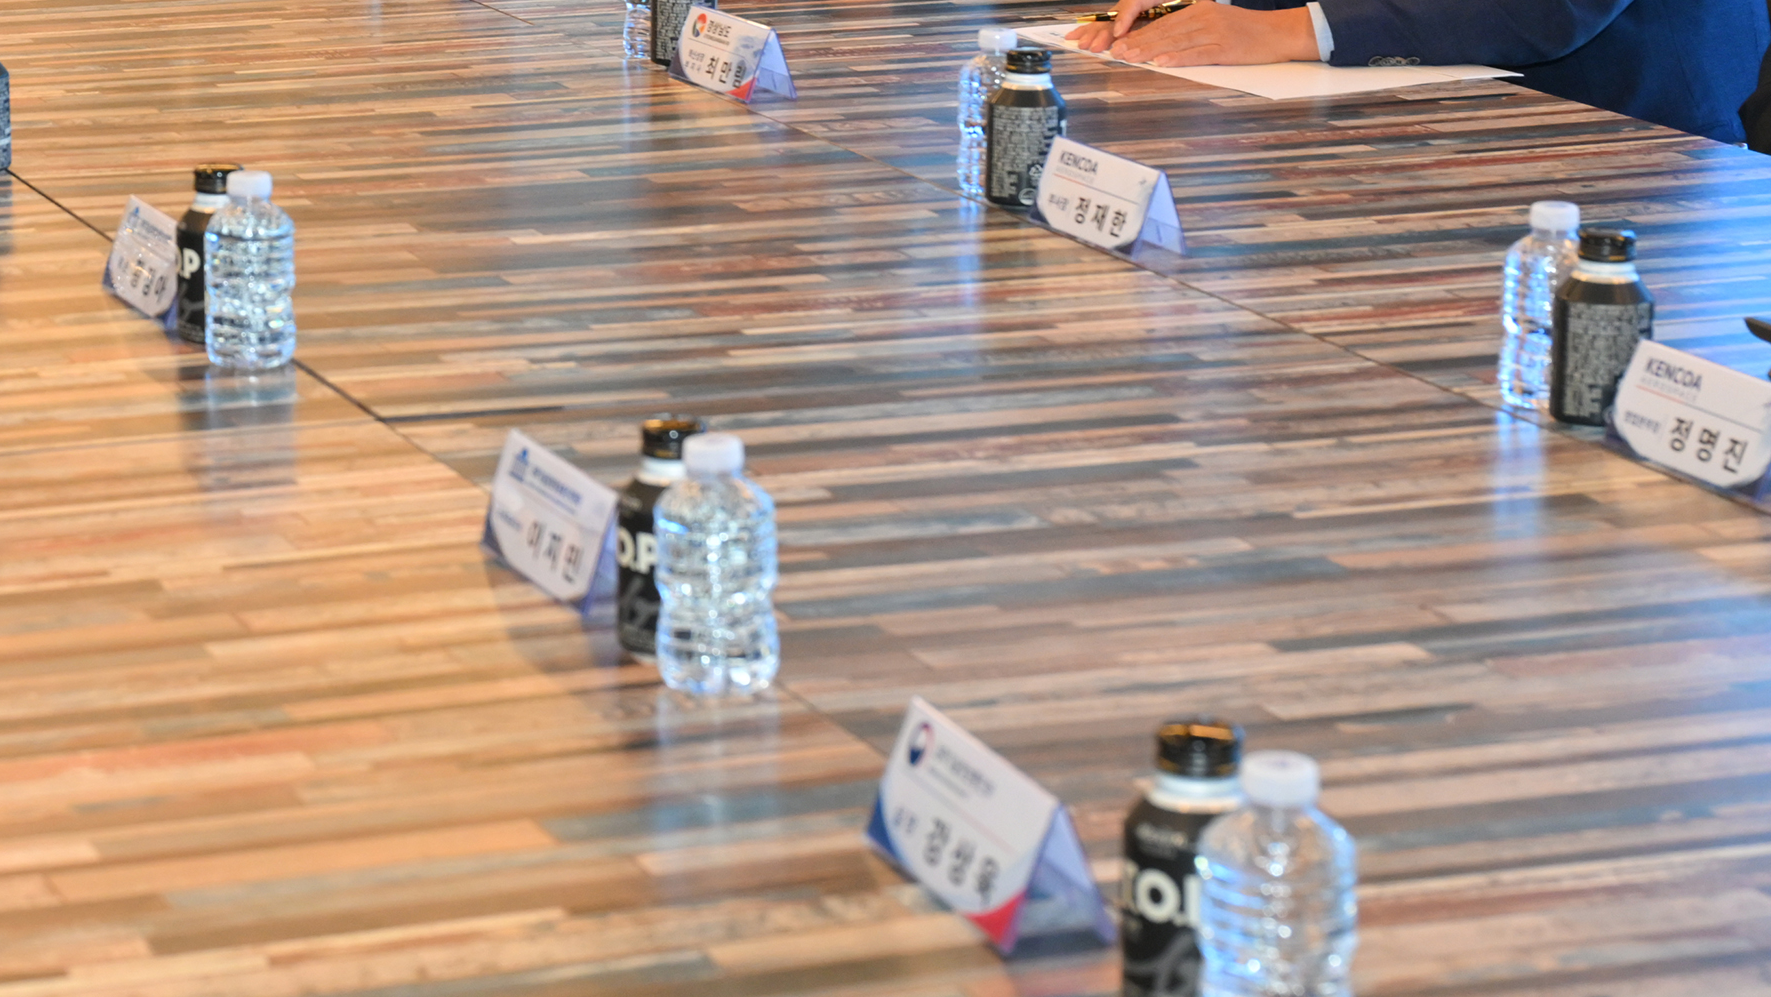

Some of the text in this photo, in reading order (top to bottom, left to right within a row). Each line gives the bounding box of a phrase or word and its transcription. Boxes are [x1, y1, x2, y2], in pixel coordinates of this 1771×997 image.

[705, 55, 746, 89] 최만림
[1060, 150, 1099, 175] KENCOA
[1074, 197, 1128, 238] 정재한
[1646, 357, 1703, 391] KENCOA
[1670, 417, 1749, 475] 정명진
